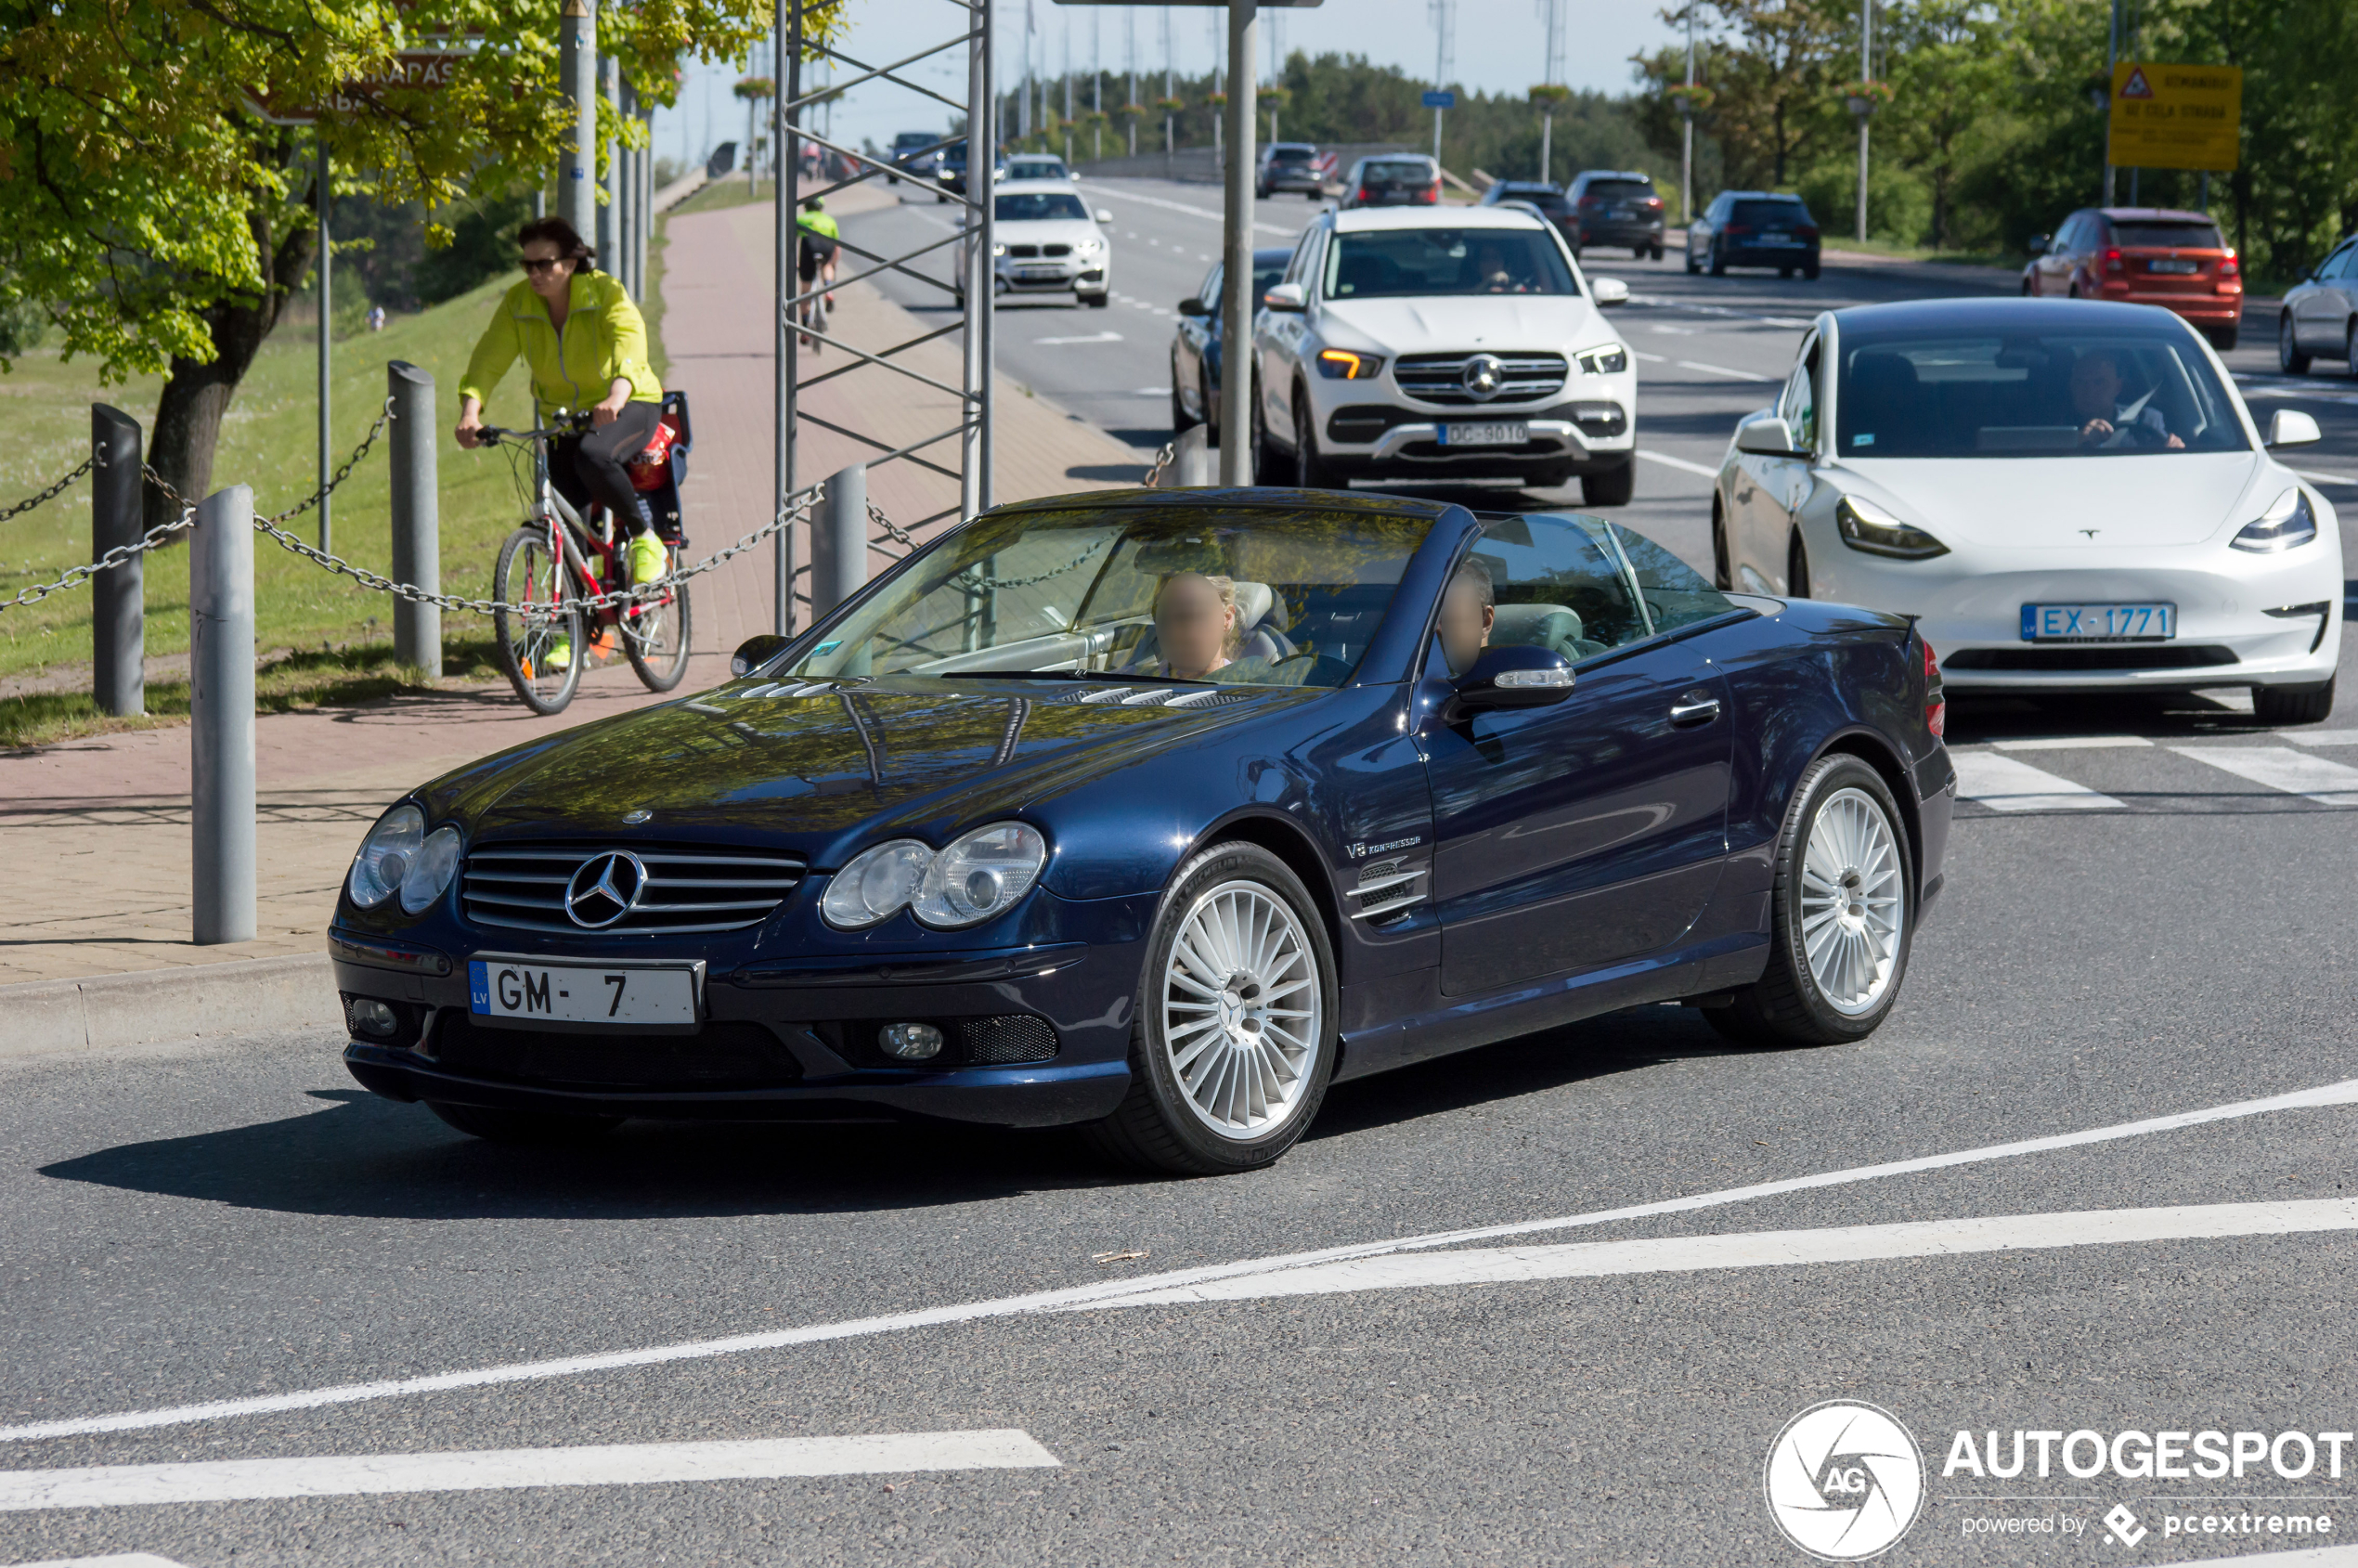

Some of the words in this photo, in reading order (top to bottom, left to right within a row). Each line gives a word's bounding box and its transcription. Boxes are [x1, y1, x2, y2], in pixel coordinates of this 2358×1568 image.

[2044, 606, 2169, 634] EX-1771
[1185, 857, 1237, 898] MICHELIN
[473, 991, 487, 1004] LV
